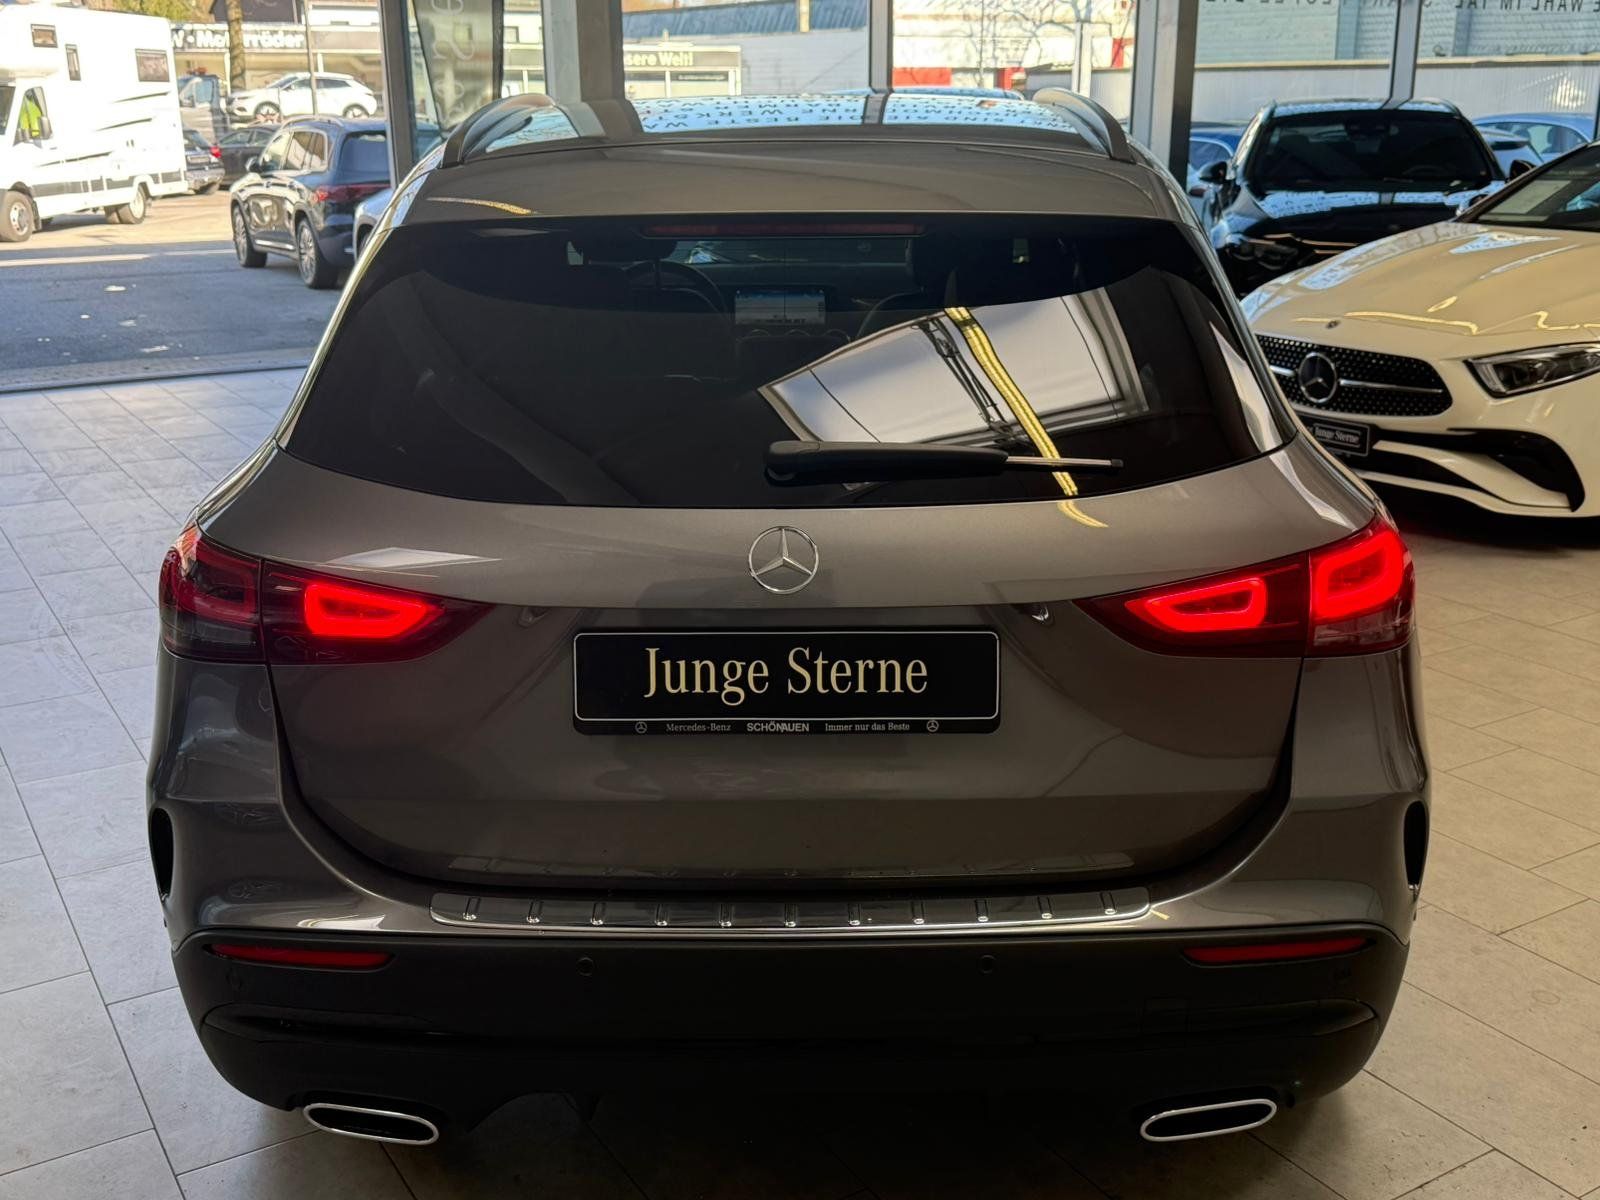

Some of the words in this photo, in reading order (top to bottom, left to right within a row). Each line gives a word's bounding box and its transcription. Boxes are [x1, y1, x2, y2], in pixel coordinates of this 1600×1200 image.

[643, 647, 769, 706] Junge
[787, 647, 928, 694] Sterne
[666, 722, 732, 733] Mercedes-Benz
[825, 723, 853, 732] Immer
[854, 724, 869, 732] nur
[871, 723, 886, 732] das
[888, 722, 910, 732] Beste
